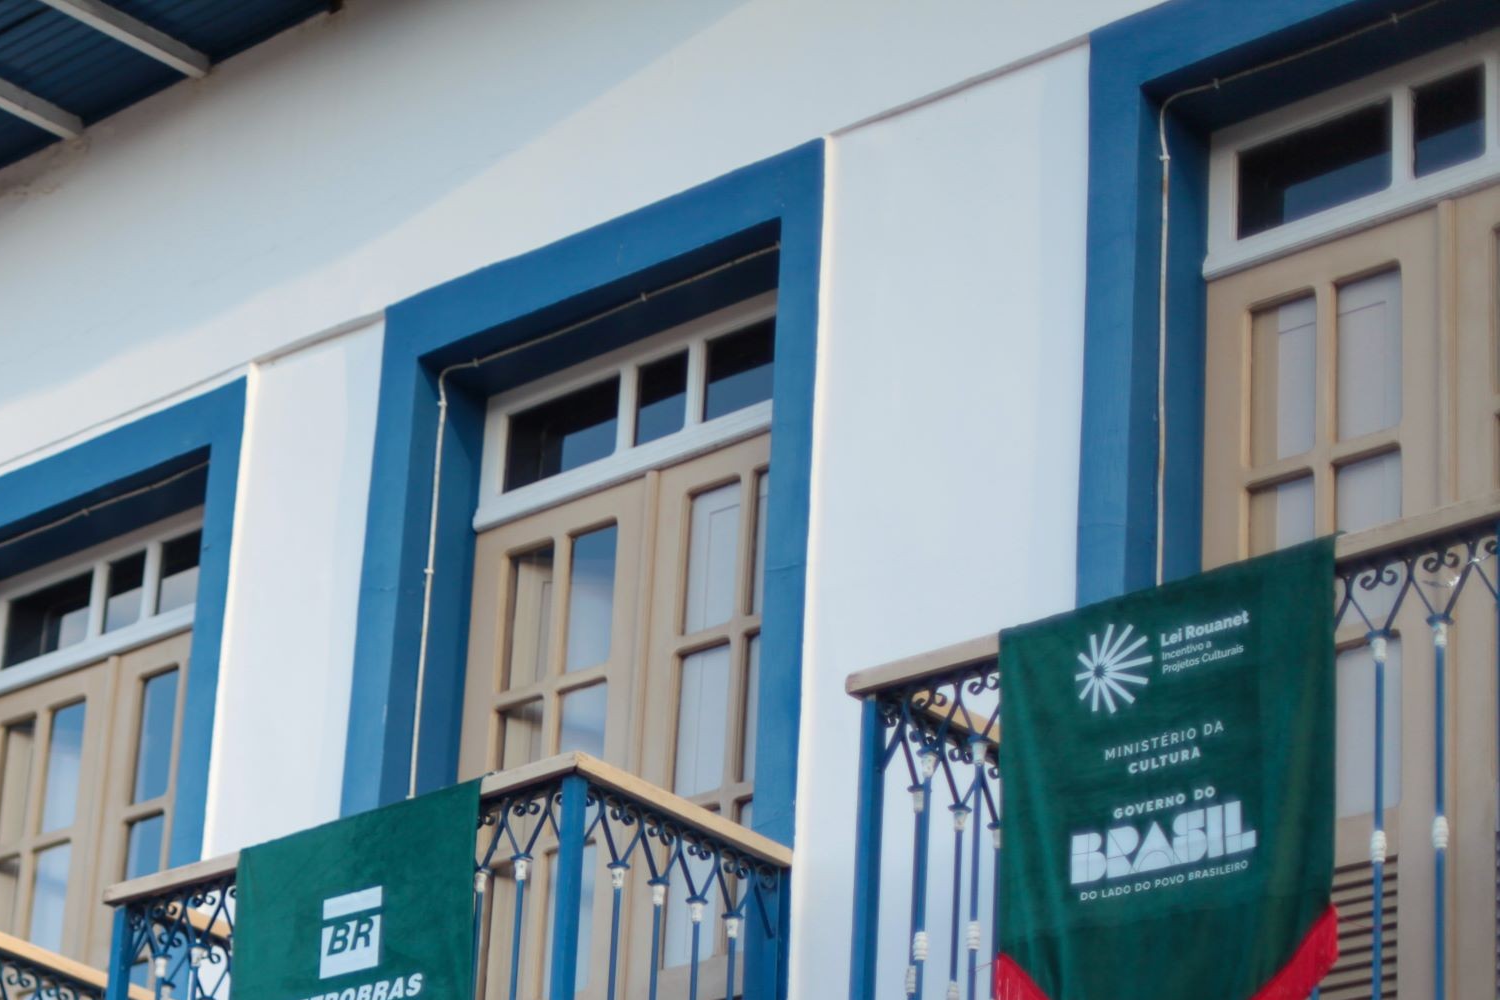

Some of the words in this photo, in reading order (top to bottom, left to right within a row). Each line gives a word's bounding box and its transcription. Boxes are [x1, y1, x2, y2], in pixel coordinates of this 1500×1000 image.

[1160, 627, 1183, 648] Lei
[1185, 609, 1250, 640] Rouanet
[1161, 642, 1204, 661] Incentivo
[1161, 657, 1200, 674] Projetos
[1201, 644, 1244, 663] Culturais
[1104, 727, 1197, 761] MINISTÉRIO
[1203, 720, 1224, 737] DA
[1128, 746, 1201, 775] CULTURA
[1113, 793, 1186, 820] GOVERNO
[1194, 786, 1216, 801] DO
[1070, 800, 1257, 885] BRASIL
[1079, 889, 1098, 901] DO
[1101, 884, 1131, 899] LADO
[1135, 880, 1151, 892] DO
[1155, 873, 1185, 888] POVO
[1188, 859, 1249, 881] BRASILEIRO
[326, 916, 375, 957] BR
